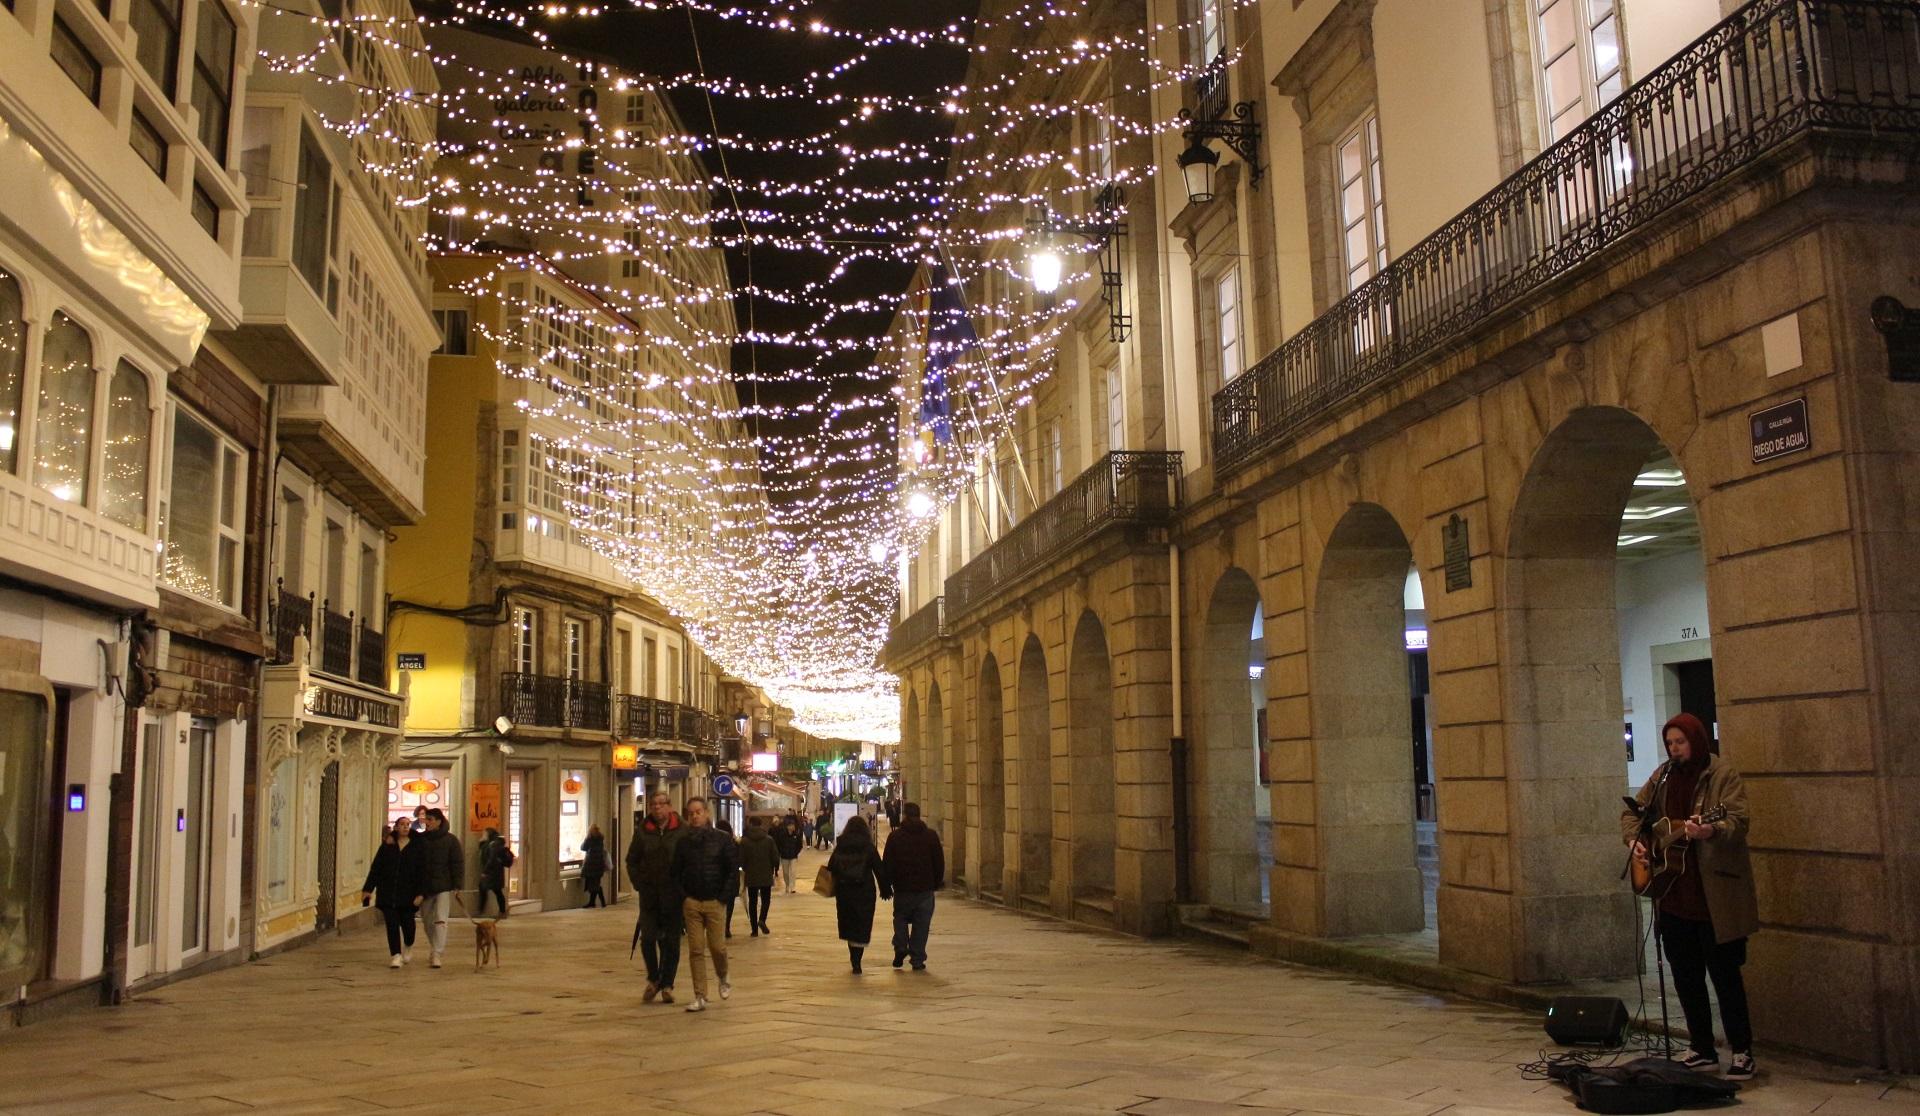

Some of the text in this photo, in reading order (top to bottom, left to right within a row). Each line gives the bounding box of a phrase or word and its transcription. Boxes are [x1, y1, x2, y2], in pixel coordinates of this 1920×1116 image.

[521, 66, 567, 84] Alda
[578, 58, 597, 206] HOTEL
[1754, 432, 1805, 457] RIEGO DE AGUA
[331, 694, 354, 718] GRAN
